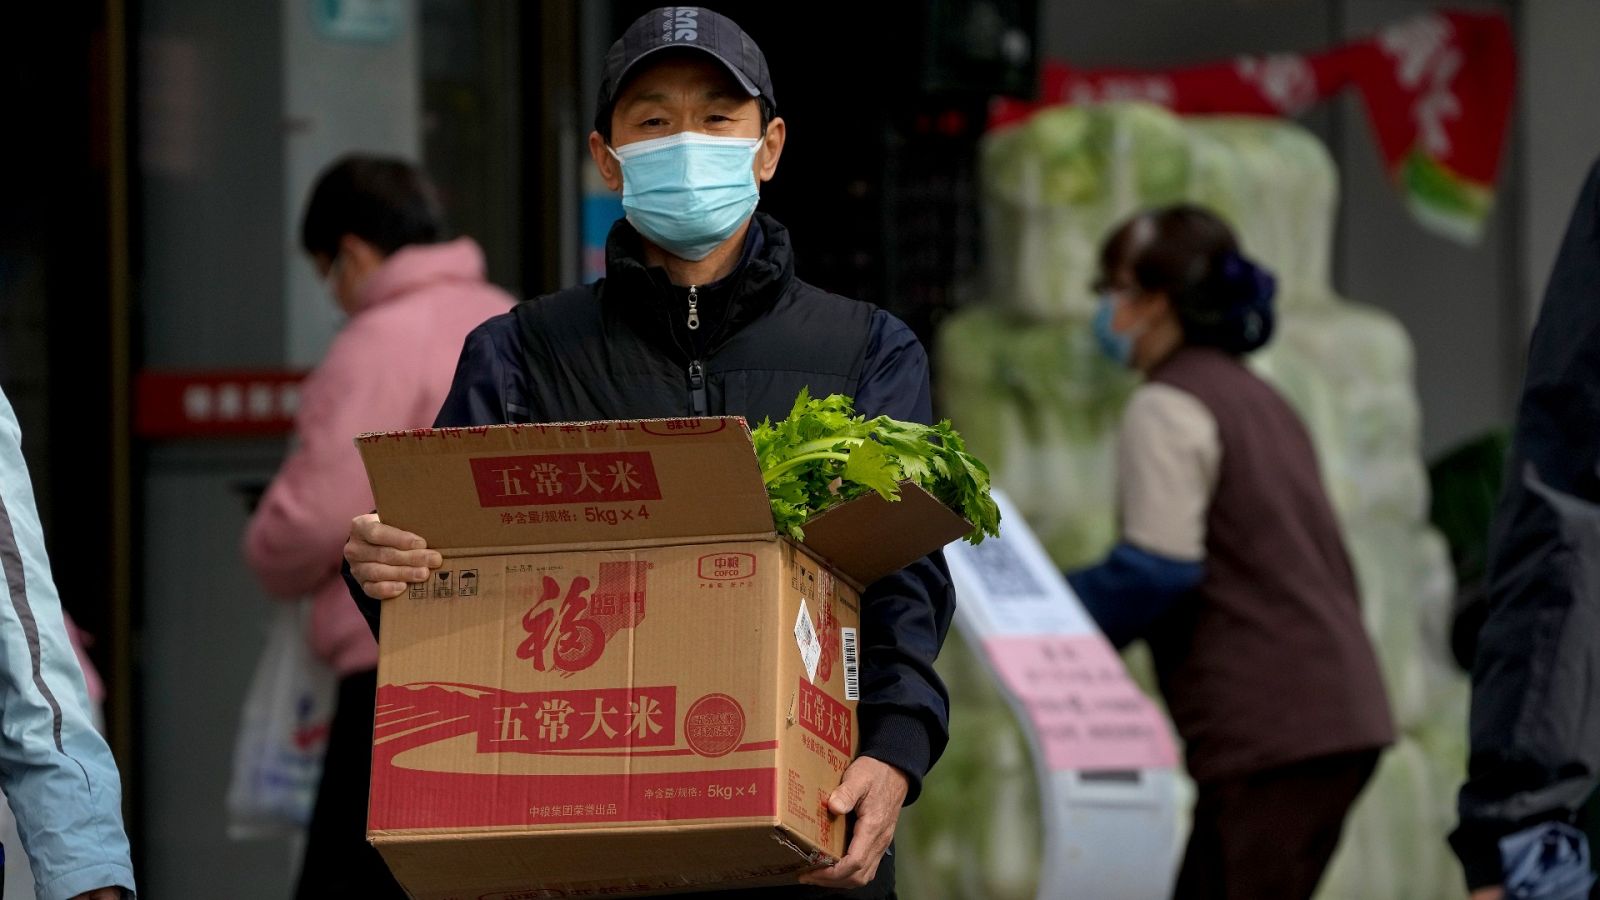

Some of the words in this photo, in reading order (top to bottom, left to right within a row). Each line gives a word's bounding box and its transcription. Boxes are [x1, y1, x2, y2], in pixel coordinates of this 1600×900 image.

[491, 460, 642, 497] 五常大米
[584, 506, 618, 525] 5kg
[714, 556, 739, 568] 中粮
[714, 569, 739, 577] COFCO
[516, 576, 606, 677] 福
[489, 695, 664, 743] 五常大米
[801, 688, 849, 748] 五常大米
[707, 783, 732, 799] 5kg
[529, 803, 617, 818] 中粮集团荣誉出品
